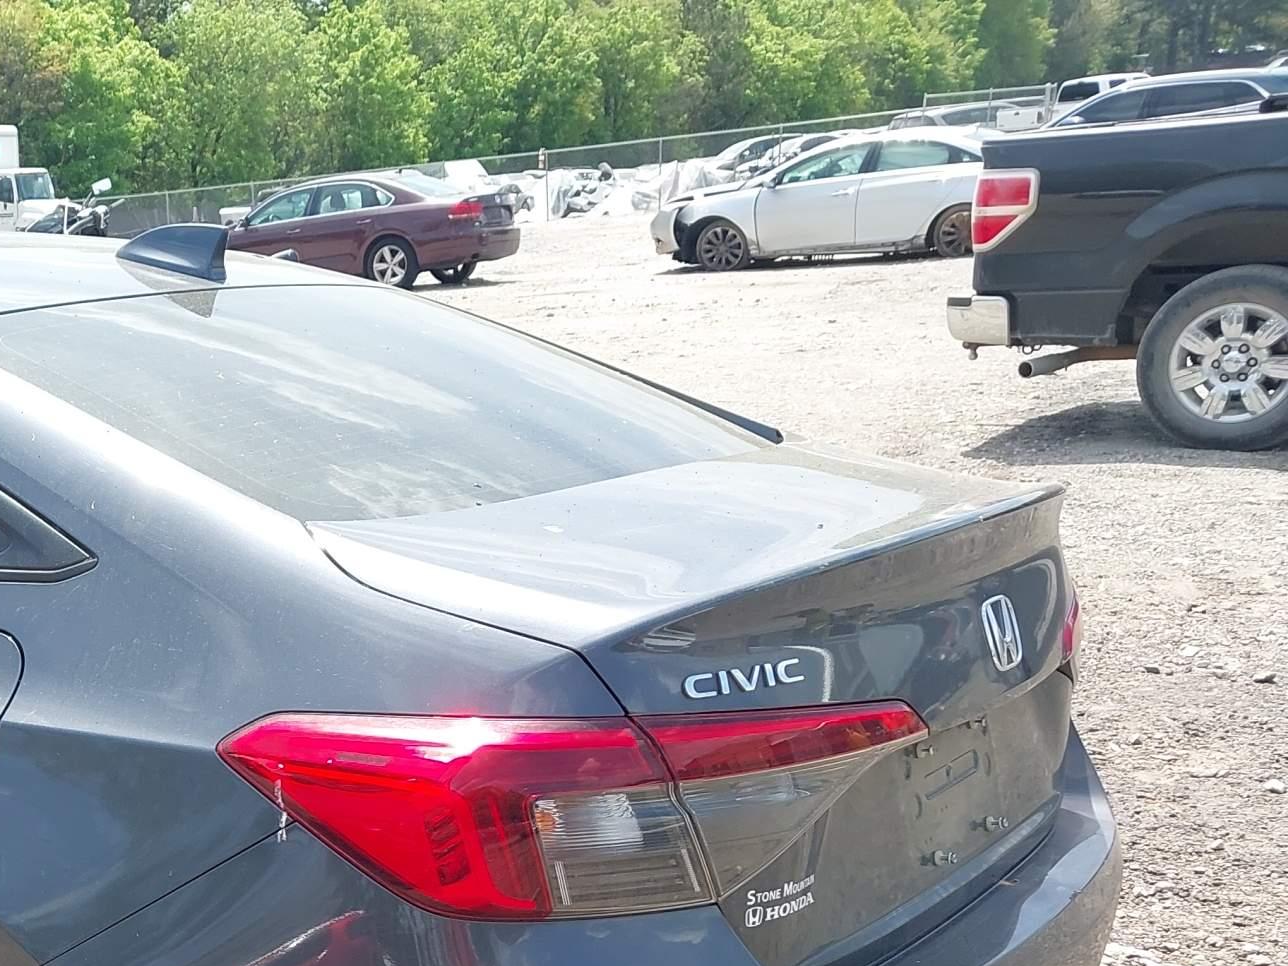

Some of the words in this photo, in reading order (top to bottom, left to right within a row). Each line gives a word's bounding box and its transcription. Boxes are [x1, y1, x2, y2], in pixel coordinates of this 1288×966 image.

[684, 658, 805, 699] CIVIC
[746, 888, 782, 905] STONE
[765, 892, 815, 921] HONDA
